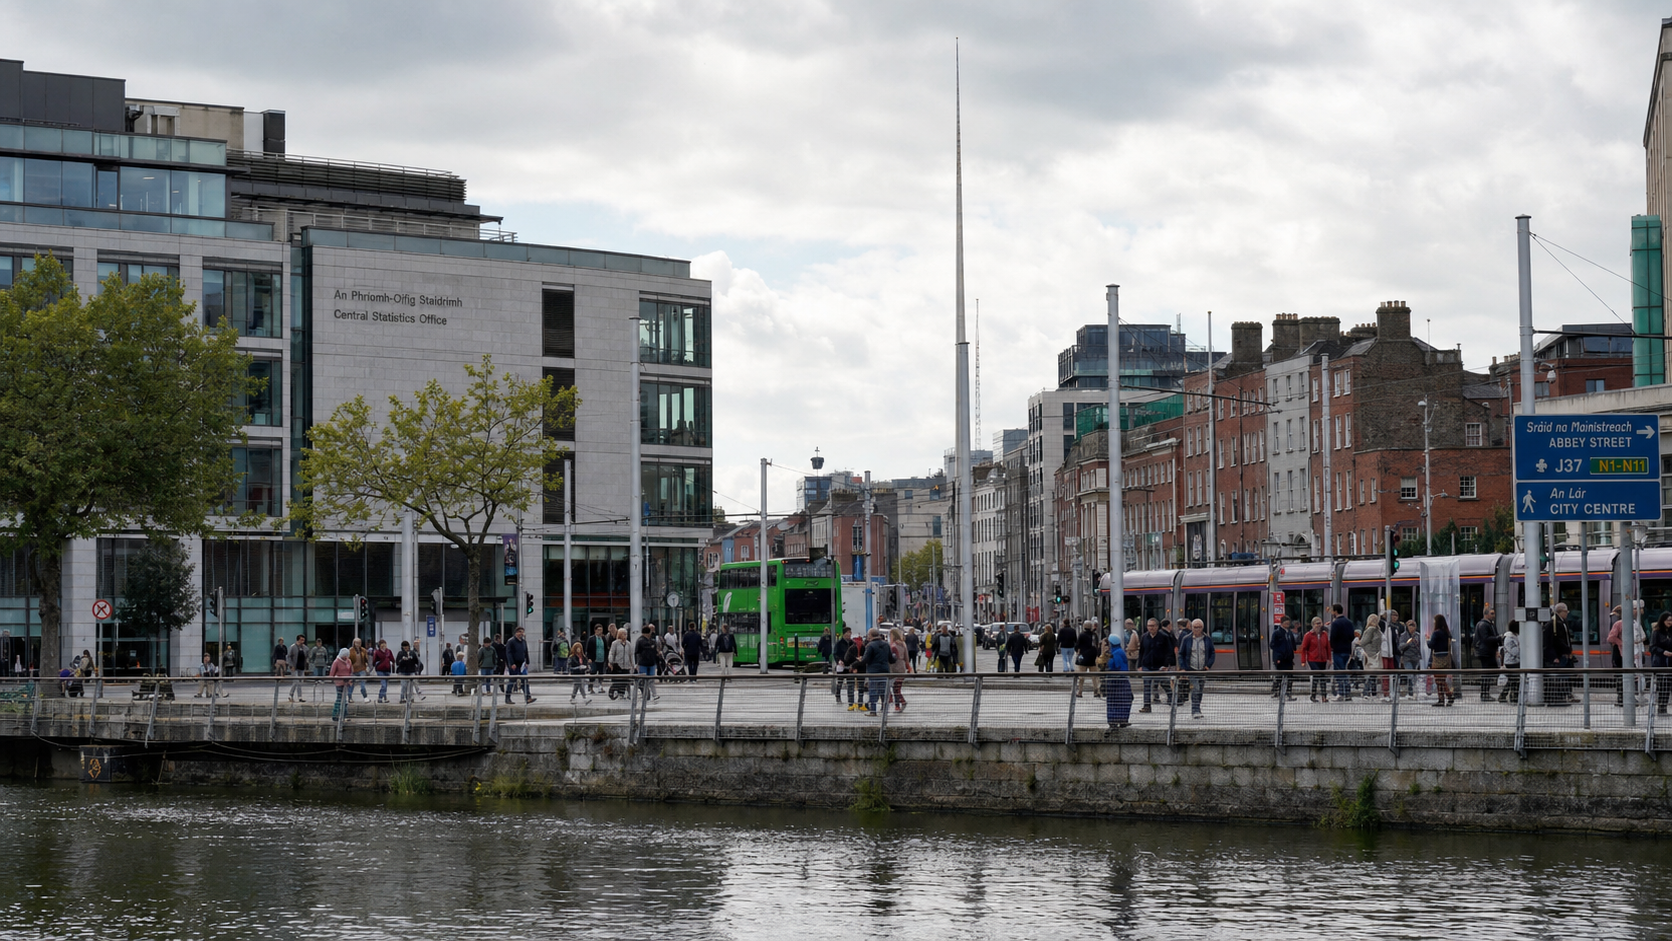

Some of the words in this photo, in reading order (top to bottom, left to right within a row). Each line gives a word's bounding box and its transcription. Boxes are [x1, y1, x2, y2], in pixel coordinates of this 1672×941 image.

[334, 289, 347, 300] An
[419, 295, 463, 307] Staidrimh
[334, 309, 368, 321] Central
[372, 311, 416, 323] Statistics
[419, 313, 447, 325] Office
[1555, 425, 1568, 433] na
[1571, 420, 1632, 433] Mainistreach
[1549, 437, 1586, 448] ABBEY
[1589, 437, 1632, 448] STREET
[1555, 458, 1582, 473] J37
[1599, 459, 1645, 472] N1-N11
[1550, 487, 1565, 499] An
[1550, 503, 1579, 515] CITY
[1584, 503, 1636, 515] CENTRE
